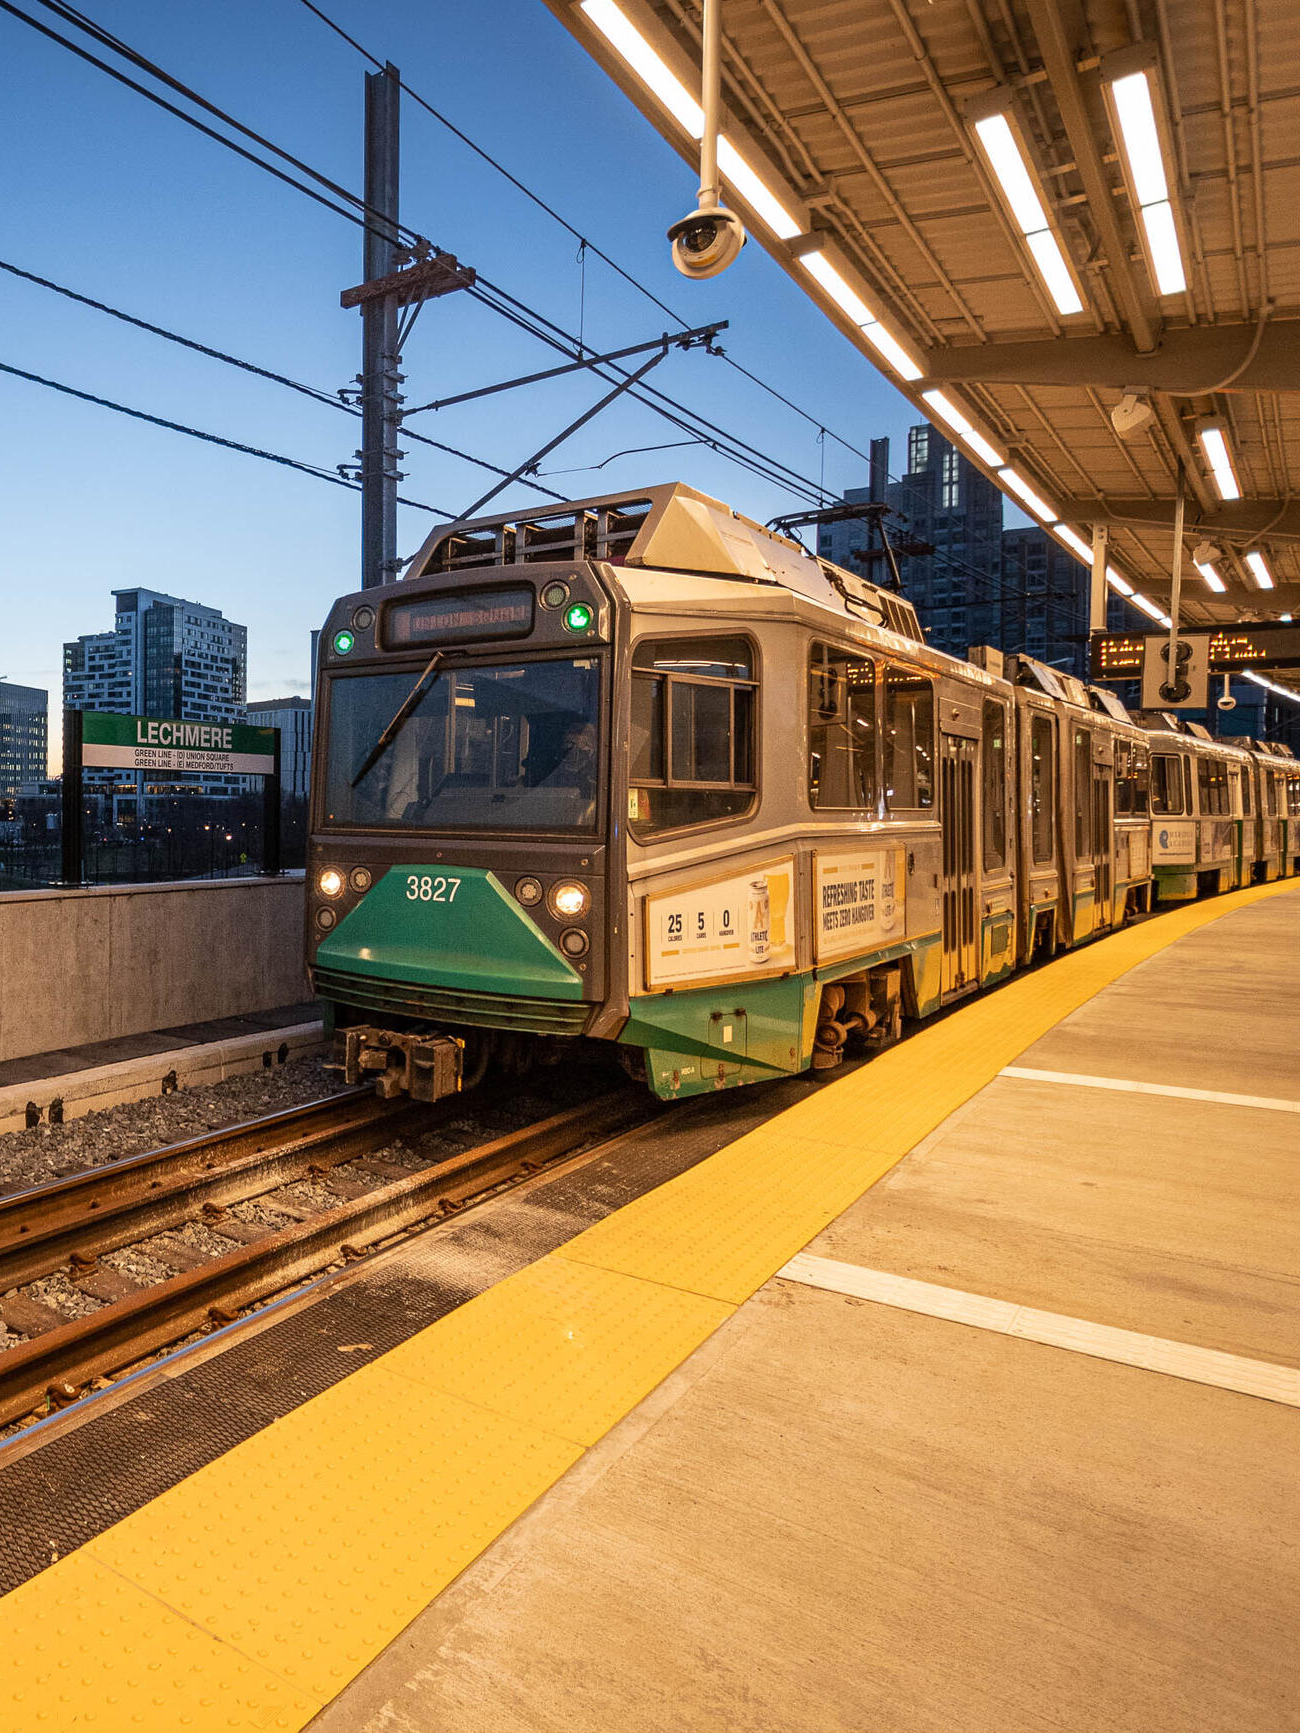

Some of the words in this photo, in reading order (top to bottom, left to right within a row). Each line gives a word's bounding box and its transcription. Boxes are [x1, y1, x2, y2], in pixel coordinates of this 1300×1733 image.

[137, 720, 233, 749] LECHMERE
[134, 748, 157, 758] GREEN
[157, 750, 172, 759] LINE
[186, 752, 205, 761] UNION
[206, 753, 230, 762] SQUARE
[135, 758, 157, 767] GREEN
[157, 759, 172, 768] LINE
[176, 760, 185, 769] (E)
[185, 761, 234, 771] MEDFORD/TUFTS
[406, 875, 461, 902] 3827
[822, 881, 858, 909] REFRESHING
[858, 879, 875, 902] TASTE
[668, 914, 683, 934] 25
[698, 912, 705, 930] 5
[723, 909, 730, 928] 0
[822, 910, 839, 932] MEETS
[839, 908, 851, 928] ZERO
[851, 903, 875, 925] HANGOVER
[755, 945, 764, 954] LITE
